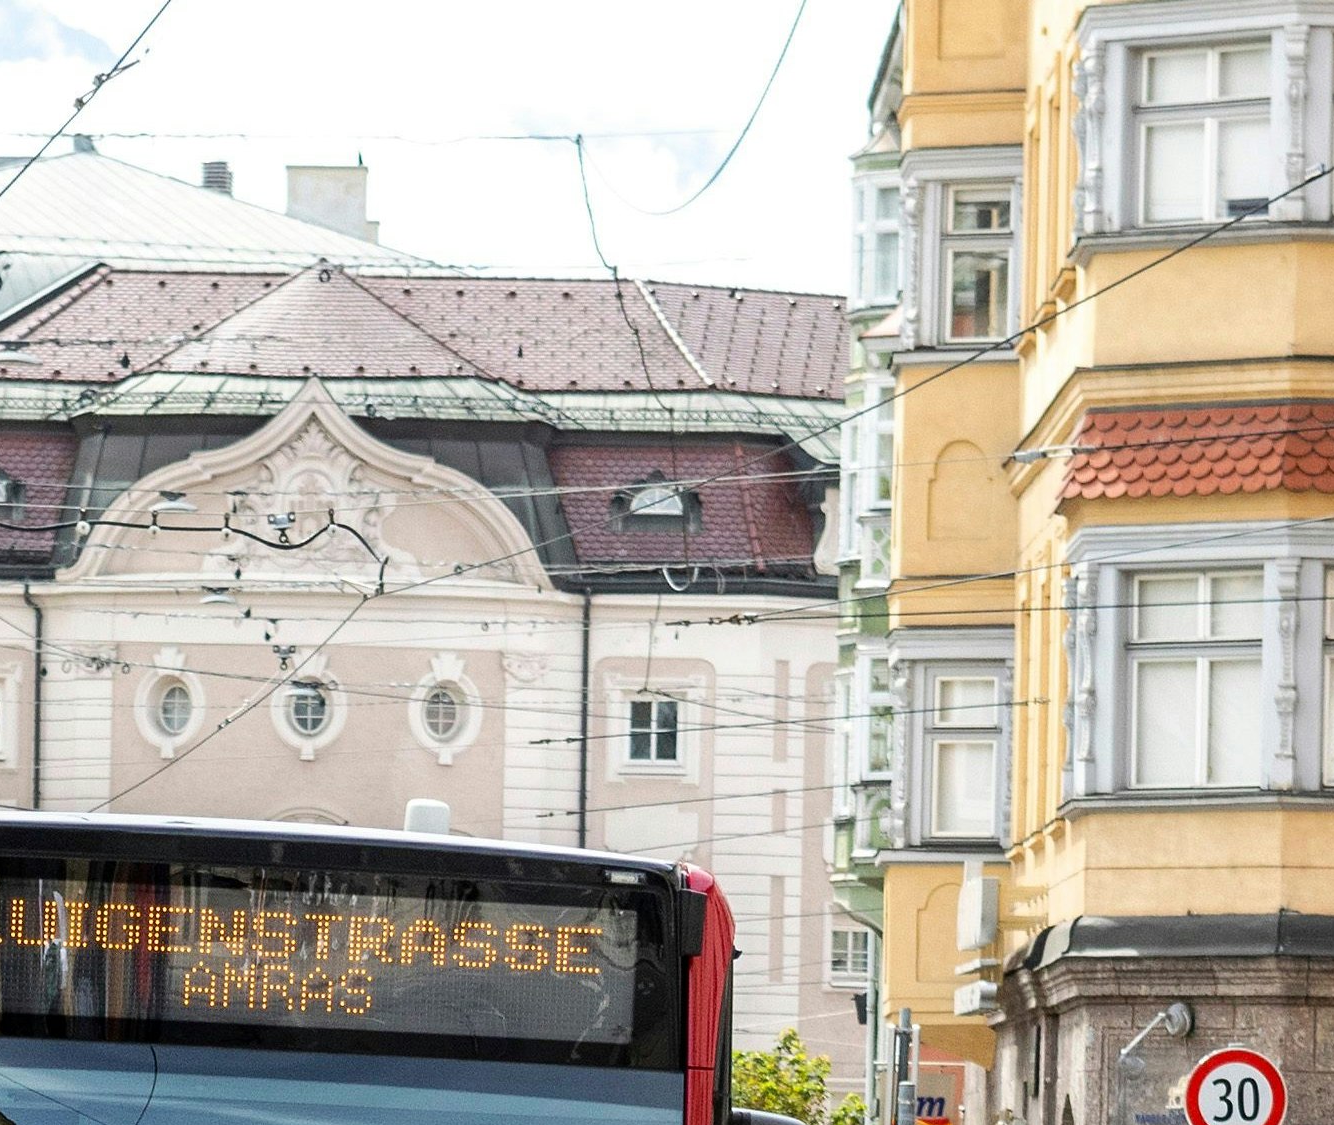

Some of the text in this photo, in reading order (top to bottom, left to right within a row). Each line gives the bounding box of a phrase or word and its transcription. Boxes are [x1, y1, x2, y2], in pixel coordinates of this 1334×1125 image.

[183, 960, 373, 1014] AMRAS
[917, 1096, 946, 1117] m
[1212, 1077, 1260, 1123] 30
